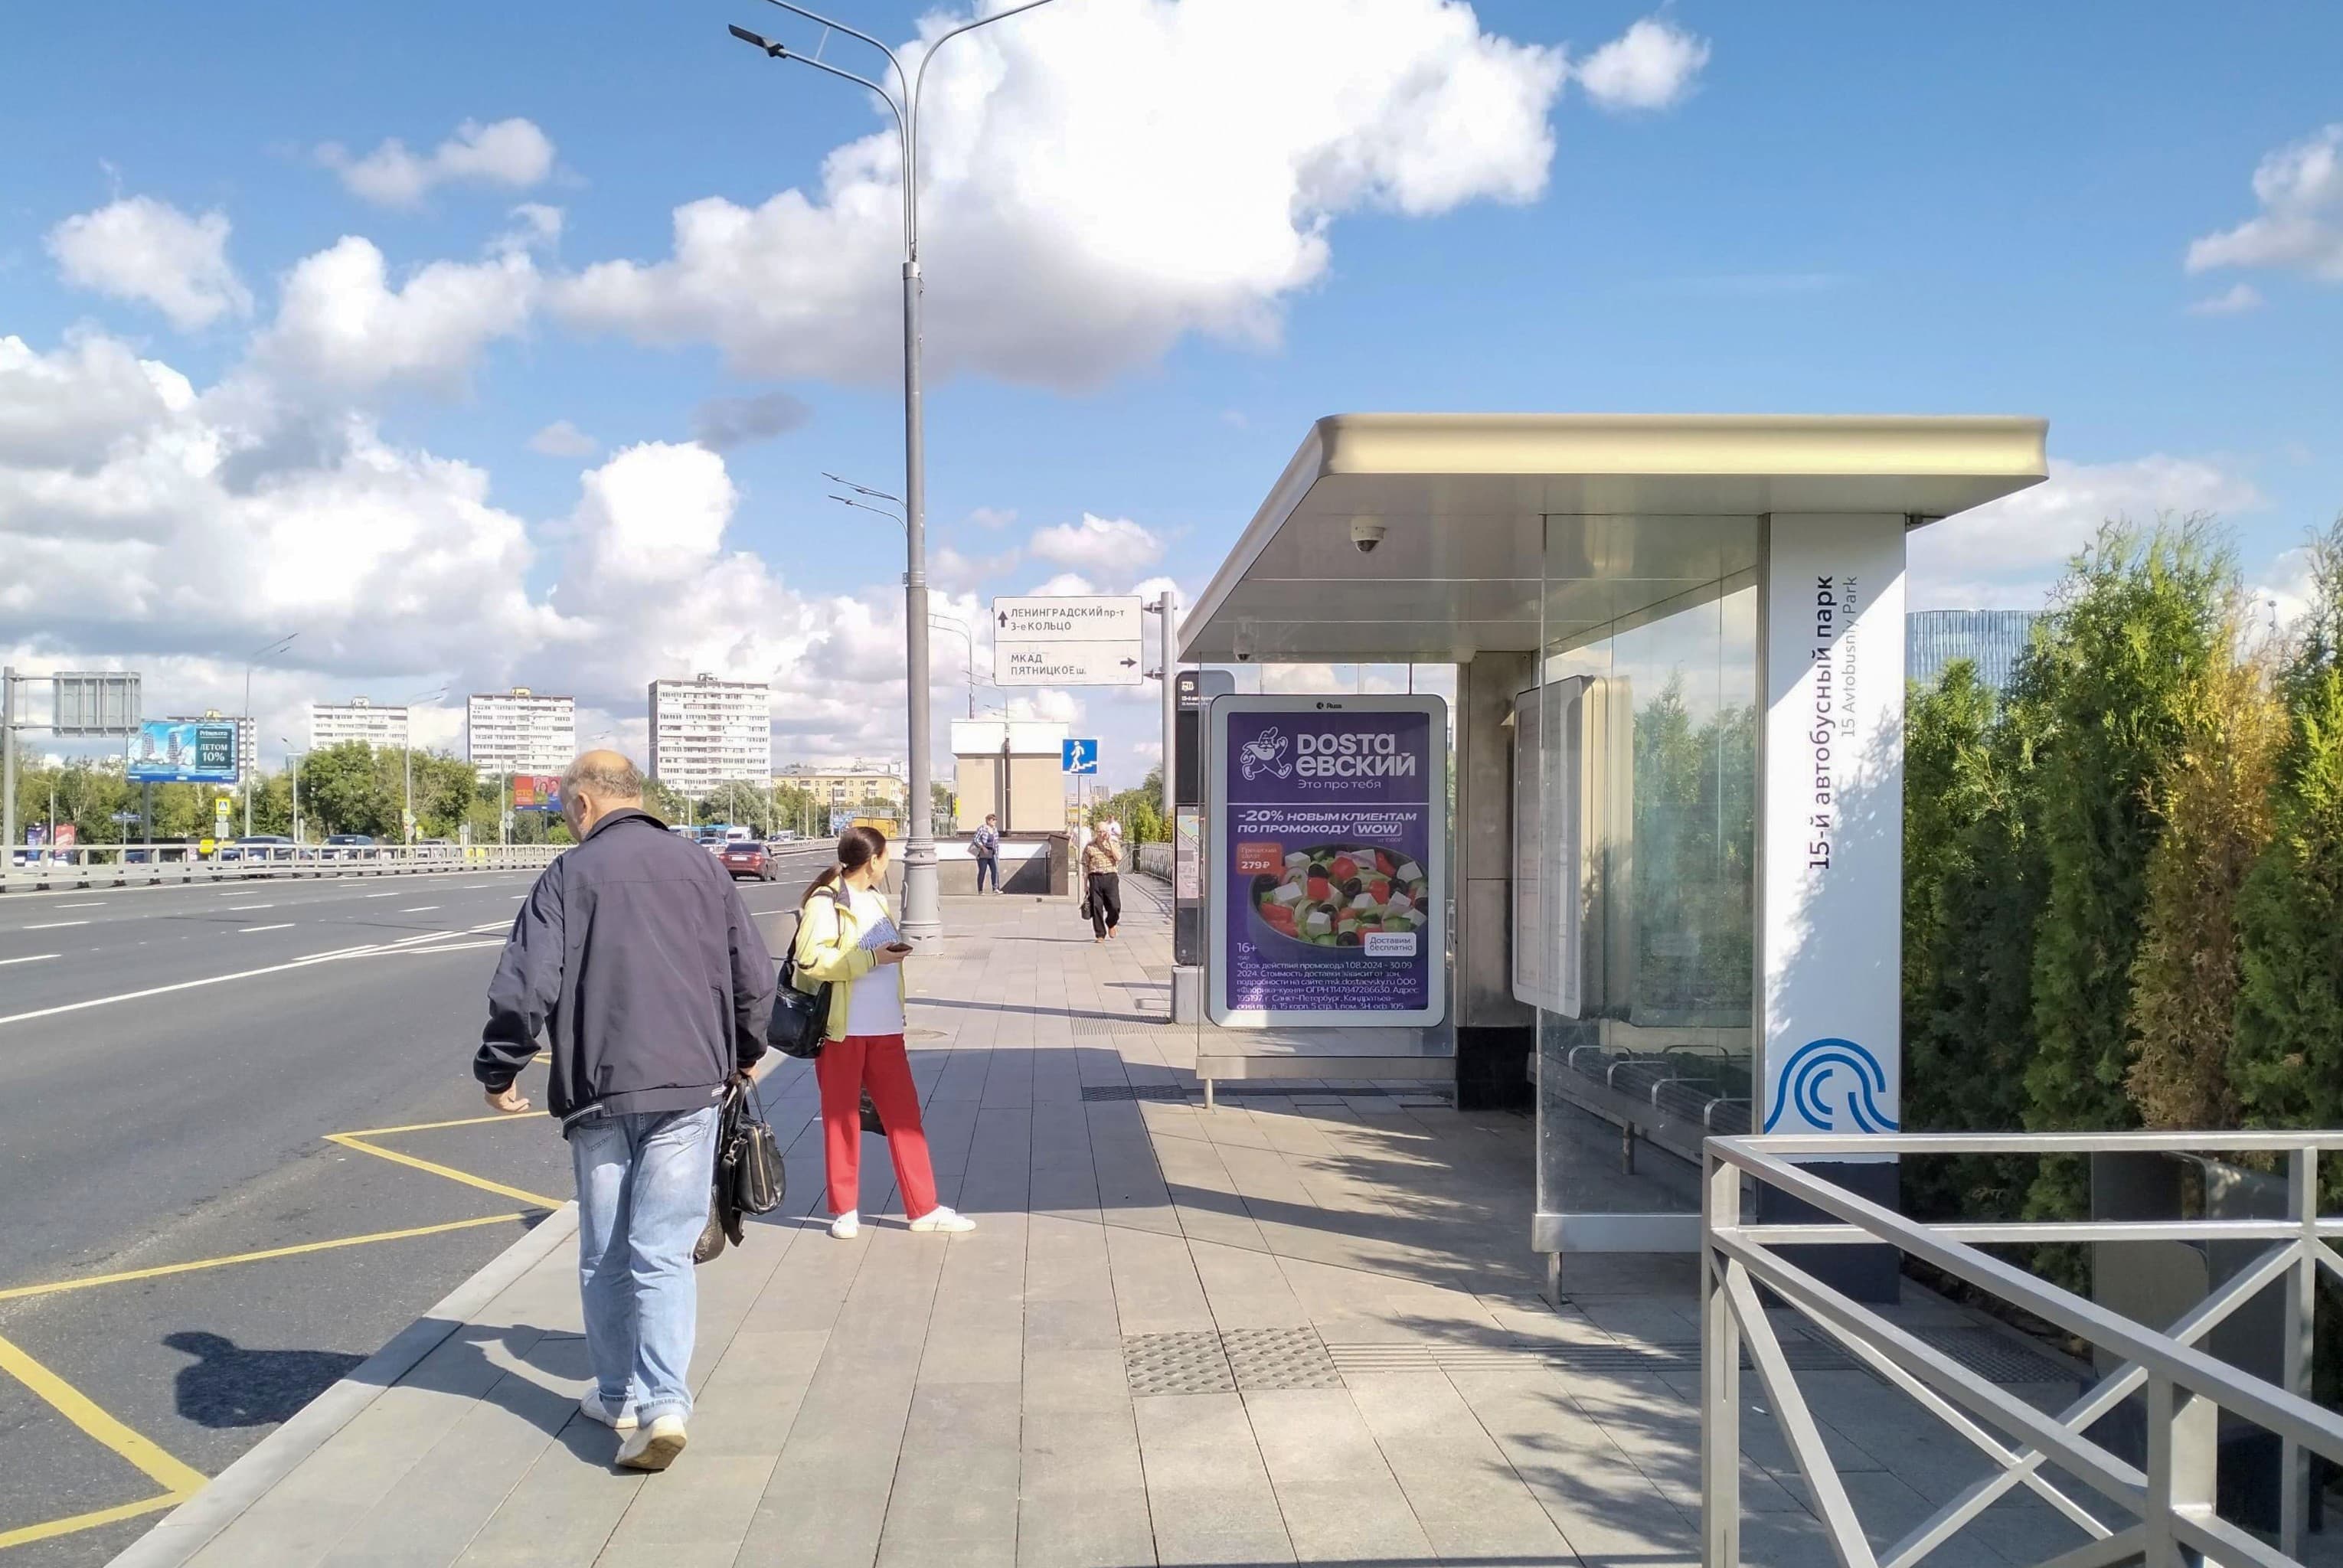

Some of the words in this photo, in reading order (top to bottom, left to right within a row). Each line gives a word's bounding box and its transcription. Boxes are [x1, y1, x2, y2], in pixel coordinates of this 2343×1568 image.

[1842, 576, 1858, 613] Park
[1011, 606, 1103, 618] ЛЕНИНГРАДСКИЙ
[1103, 609, 1125, 618] пр-т
[1817, 575, 1838, 638] парк
[1011, 622, 1026, 631] 3-е
[1028, 622, 1072, 632] КОЛЬЦО
[1011, 654, 1043, 664] МКАД
[1011, 666, 1075, 676] ПЯТНИЦКОЕ
[1841, 620, 1859, 714] Avtobusniy
[1809, 646, 1835, 805] автобусный
[1841, 717, 1855, 737] 15
[202, 752, 225, 762] 10%
[1298, 779, 1322, 789] Это
[1325, 780, 1349, 790] про
[1351, 779, 1381, 789] тебя
[1341, 812, 1417, 822] КЛИЕНТАМ
[1237, 825, 1257, 833] ПО
[1260, 825, 1350, 835] ПРОМОКОДУ
[1357, 825, 1398, 834] WOW
[1809, 815, 1829, 870] 15-й
[1369, 936, 1410, 945] Доставим
[1237, 942, 1257, 953] 16+
[1262, 962, 1299, 970] действия
